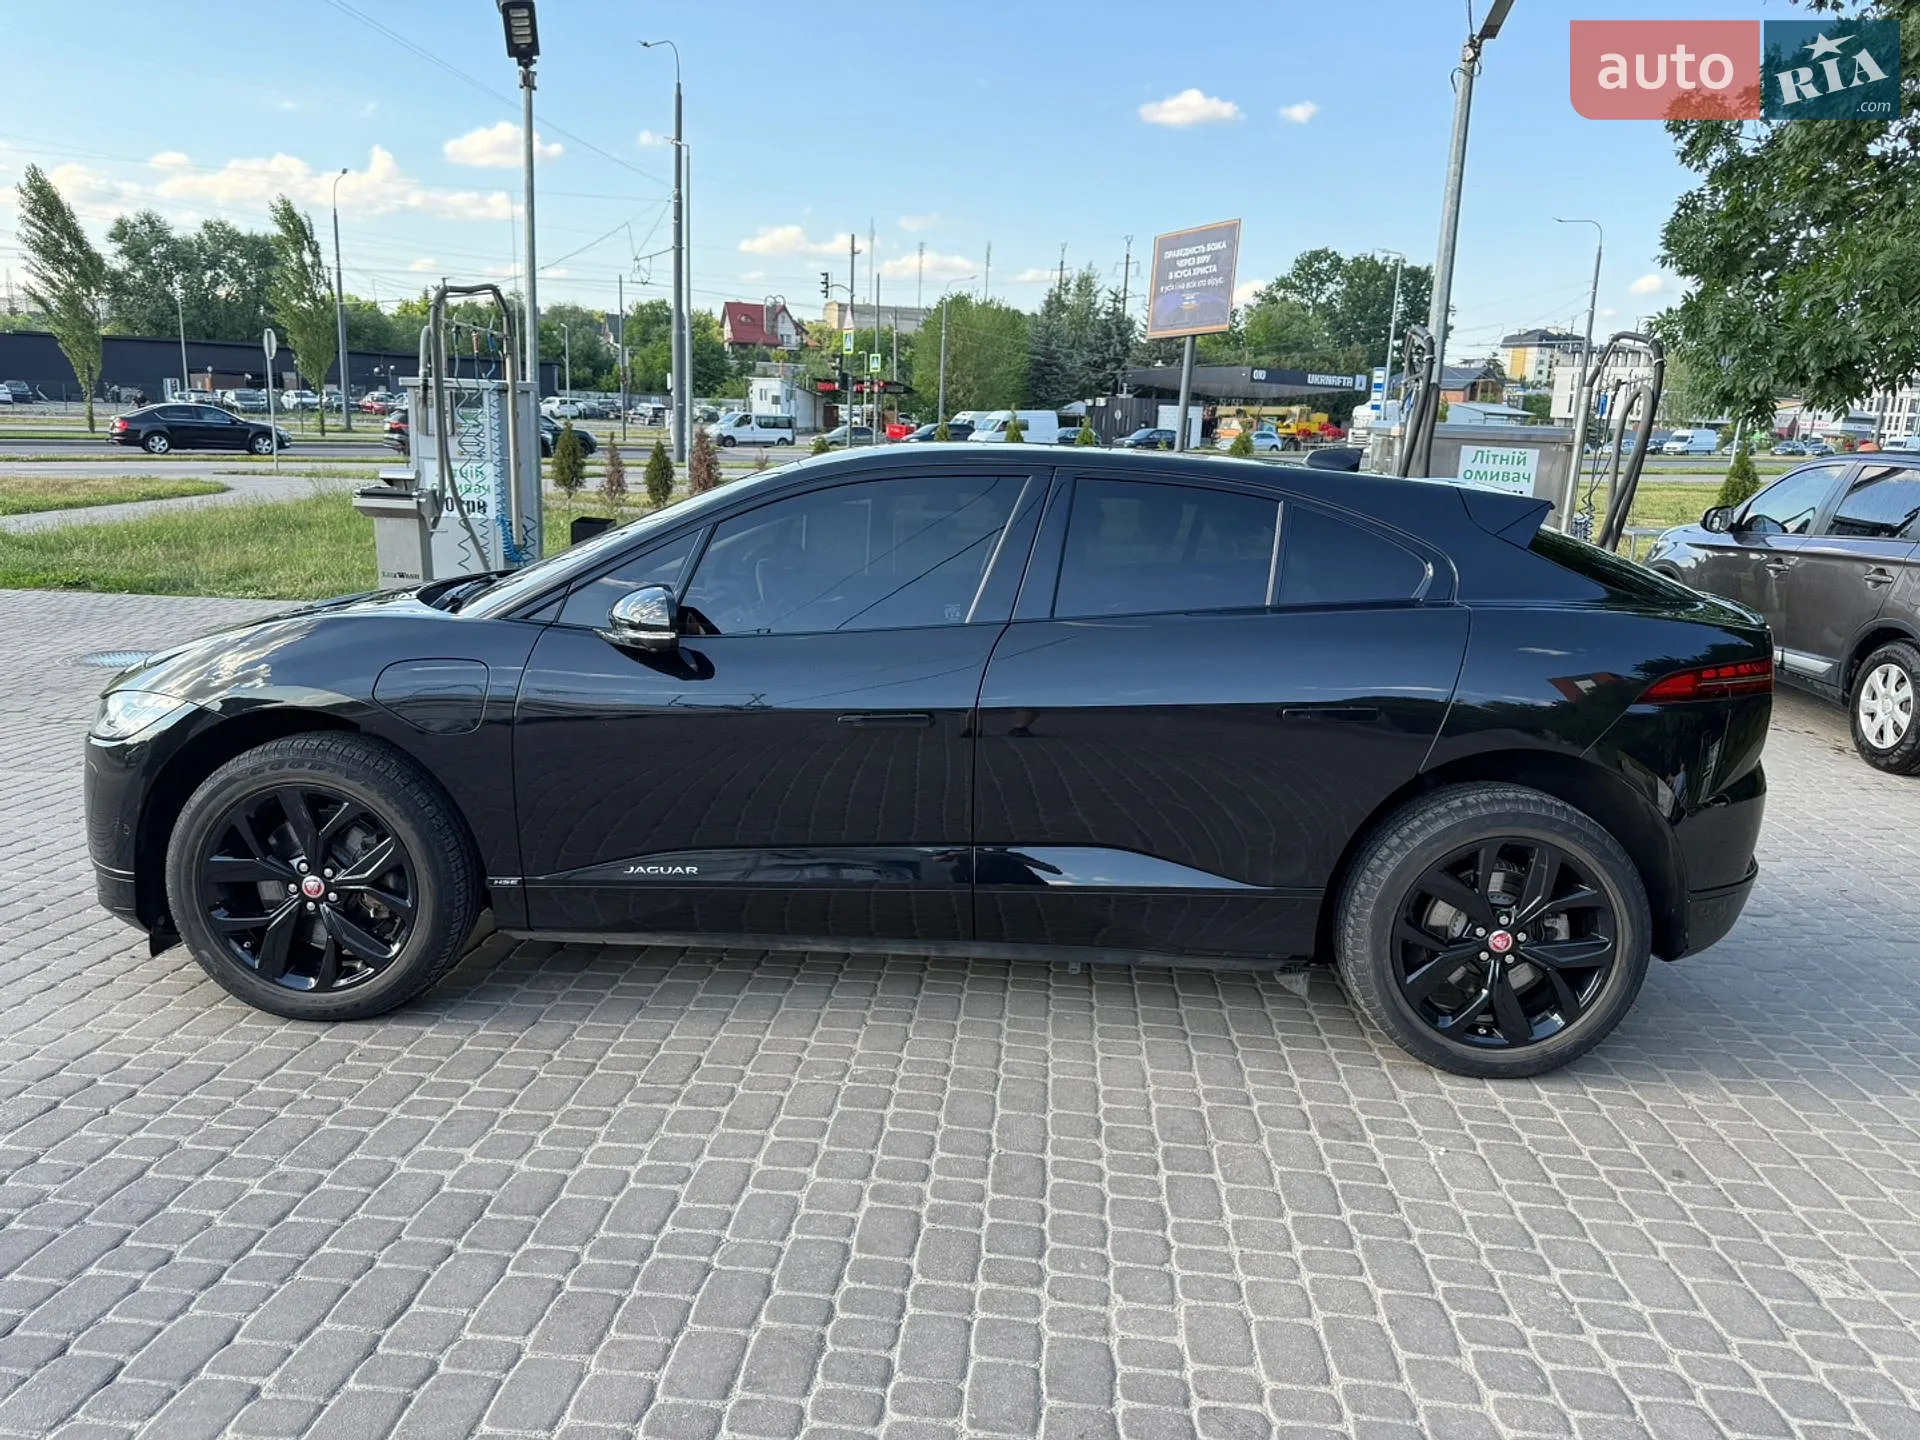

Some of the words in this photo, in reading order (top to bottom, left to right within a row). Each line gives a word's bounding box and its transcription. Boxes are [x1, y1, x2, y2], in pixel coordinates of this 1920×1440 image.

[1307, 373, 1354, 387] UKRNAFTA
[1471, 448, 1527, 467] Літній
[1462, 469, 1531, 483] омивач
[623, 865, 699, 875] JAGUAR
[493, 878, 520, 886] HSE
